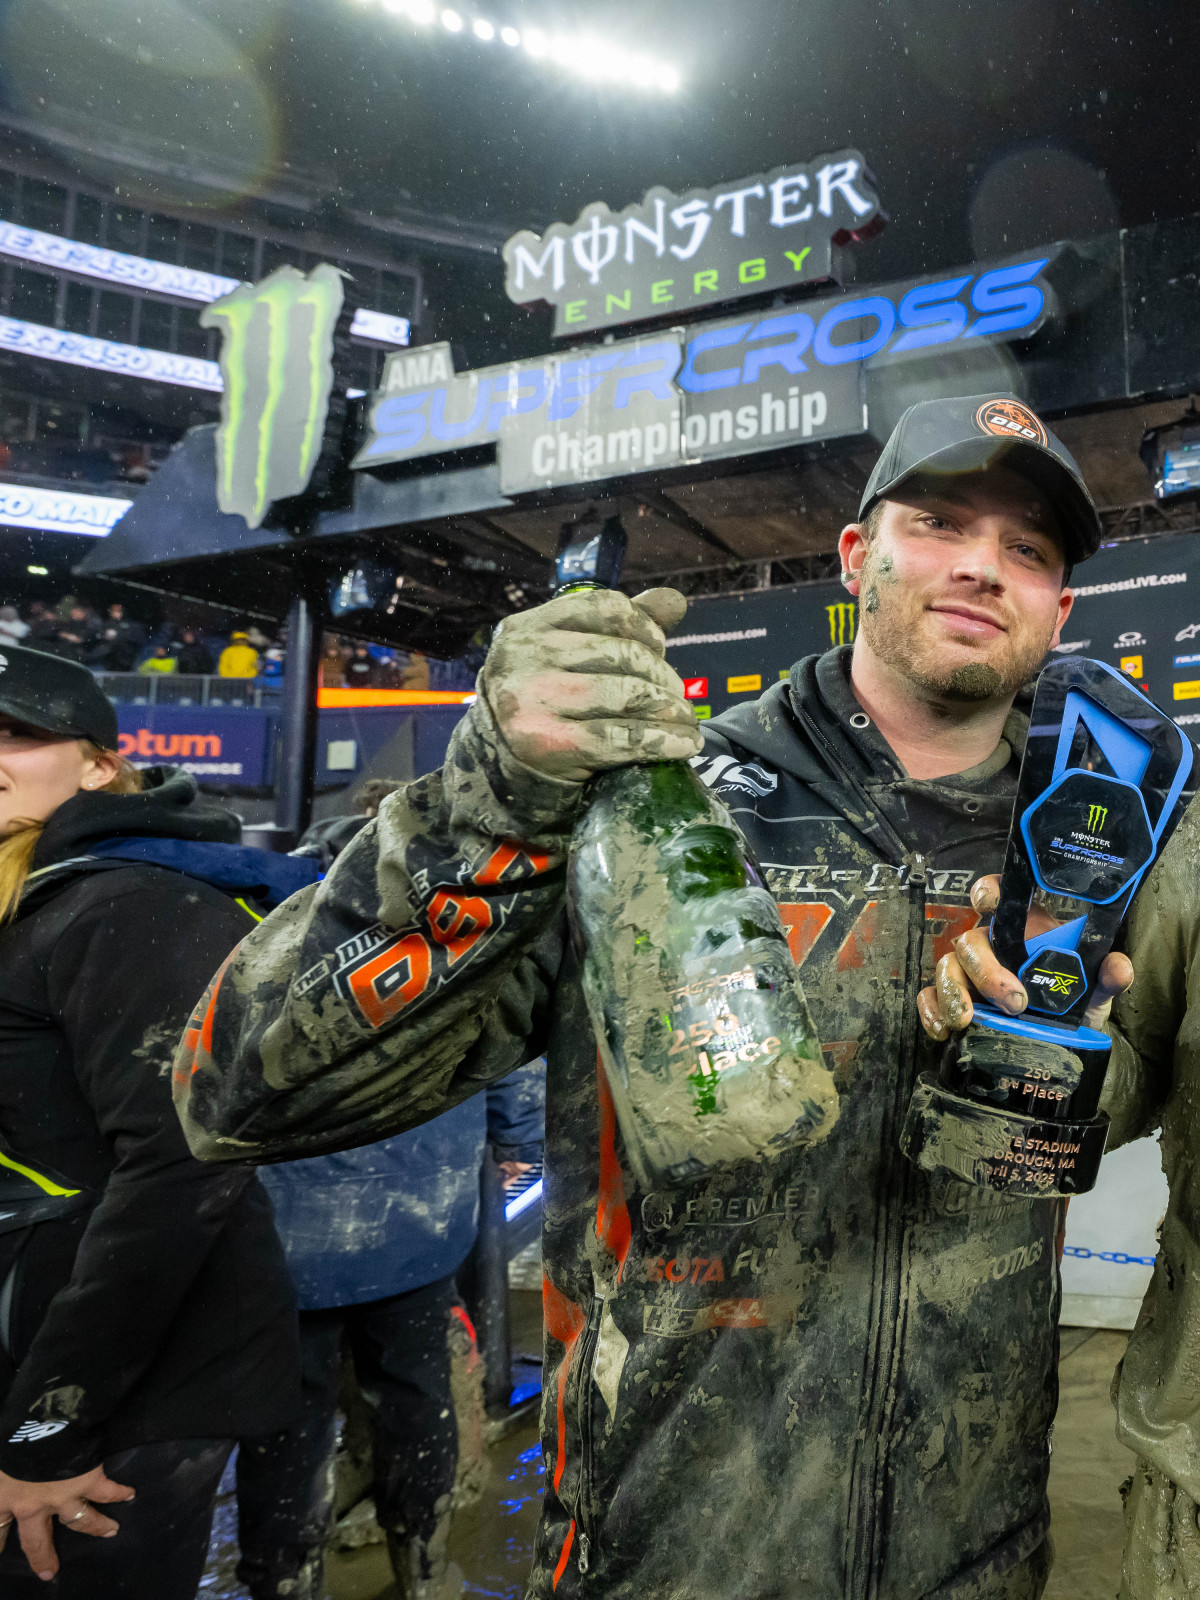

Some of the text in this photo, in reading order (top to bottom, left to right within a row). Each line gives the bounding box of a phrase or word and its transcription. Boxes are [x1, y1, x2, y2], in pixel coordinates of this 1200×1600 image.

[513, 157, 874, 292] MONSTER
[564, 246, 813, 324] ENERGY
[364, 258, 1050, 456] SUPERCROSS
[387, 350, 449, 391] AMA
[531, 385, 829, 478] Championship
[990, 415, 1037, 439] DBD
[1072, 573, 1187, 597] PERCROSSLIVE.COM
[181, 761, 243, 776] OUNGE
[1071, 831, 1111, 848] MONSTER
[1050, 840, 1125, 865] SUPERCROSS
[1063, 852, 1108, 868] CHAMPIONSHIP
[1030, 974, 1075, 996] SMX
[668, 1013, 739, 1057] 250
[687, 1036, 782, 1077] lace
[1024, 1068, 1052, 1081] 250
[1022, 1082, 1065, 1101] Place
[1025, 1138, 1081, 1154] STADIUM
[1058, 1158, 1076, 1169] MA
[1025, 1170, 1056, 1185] 2025
